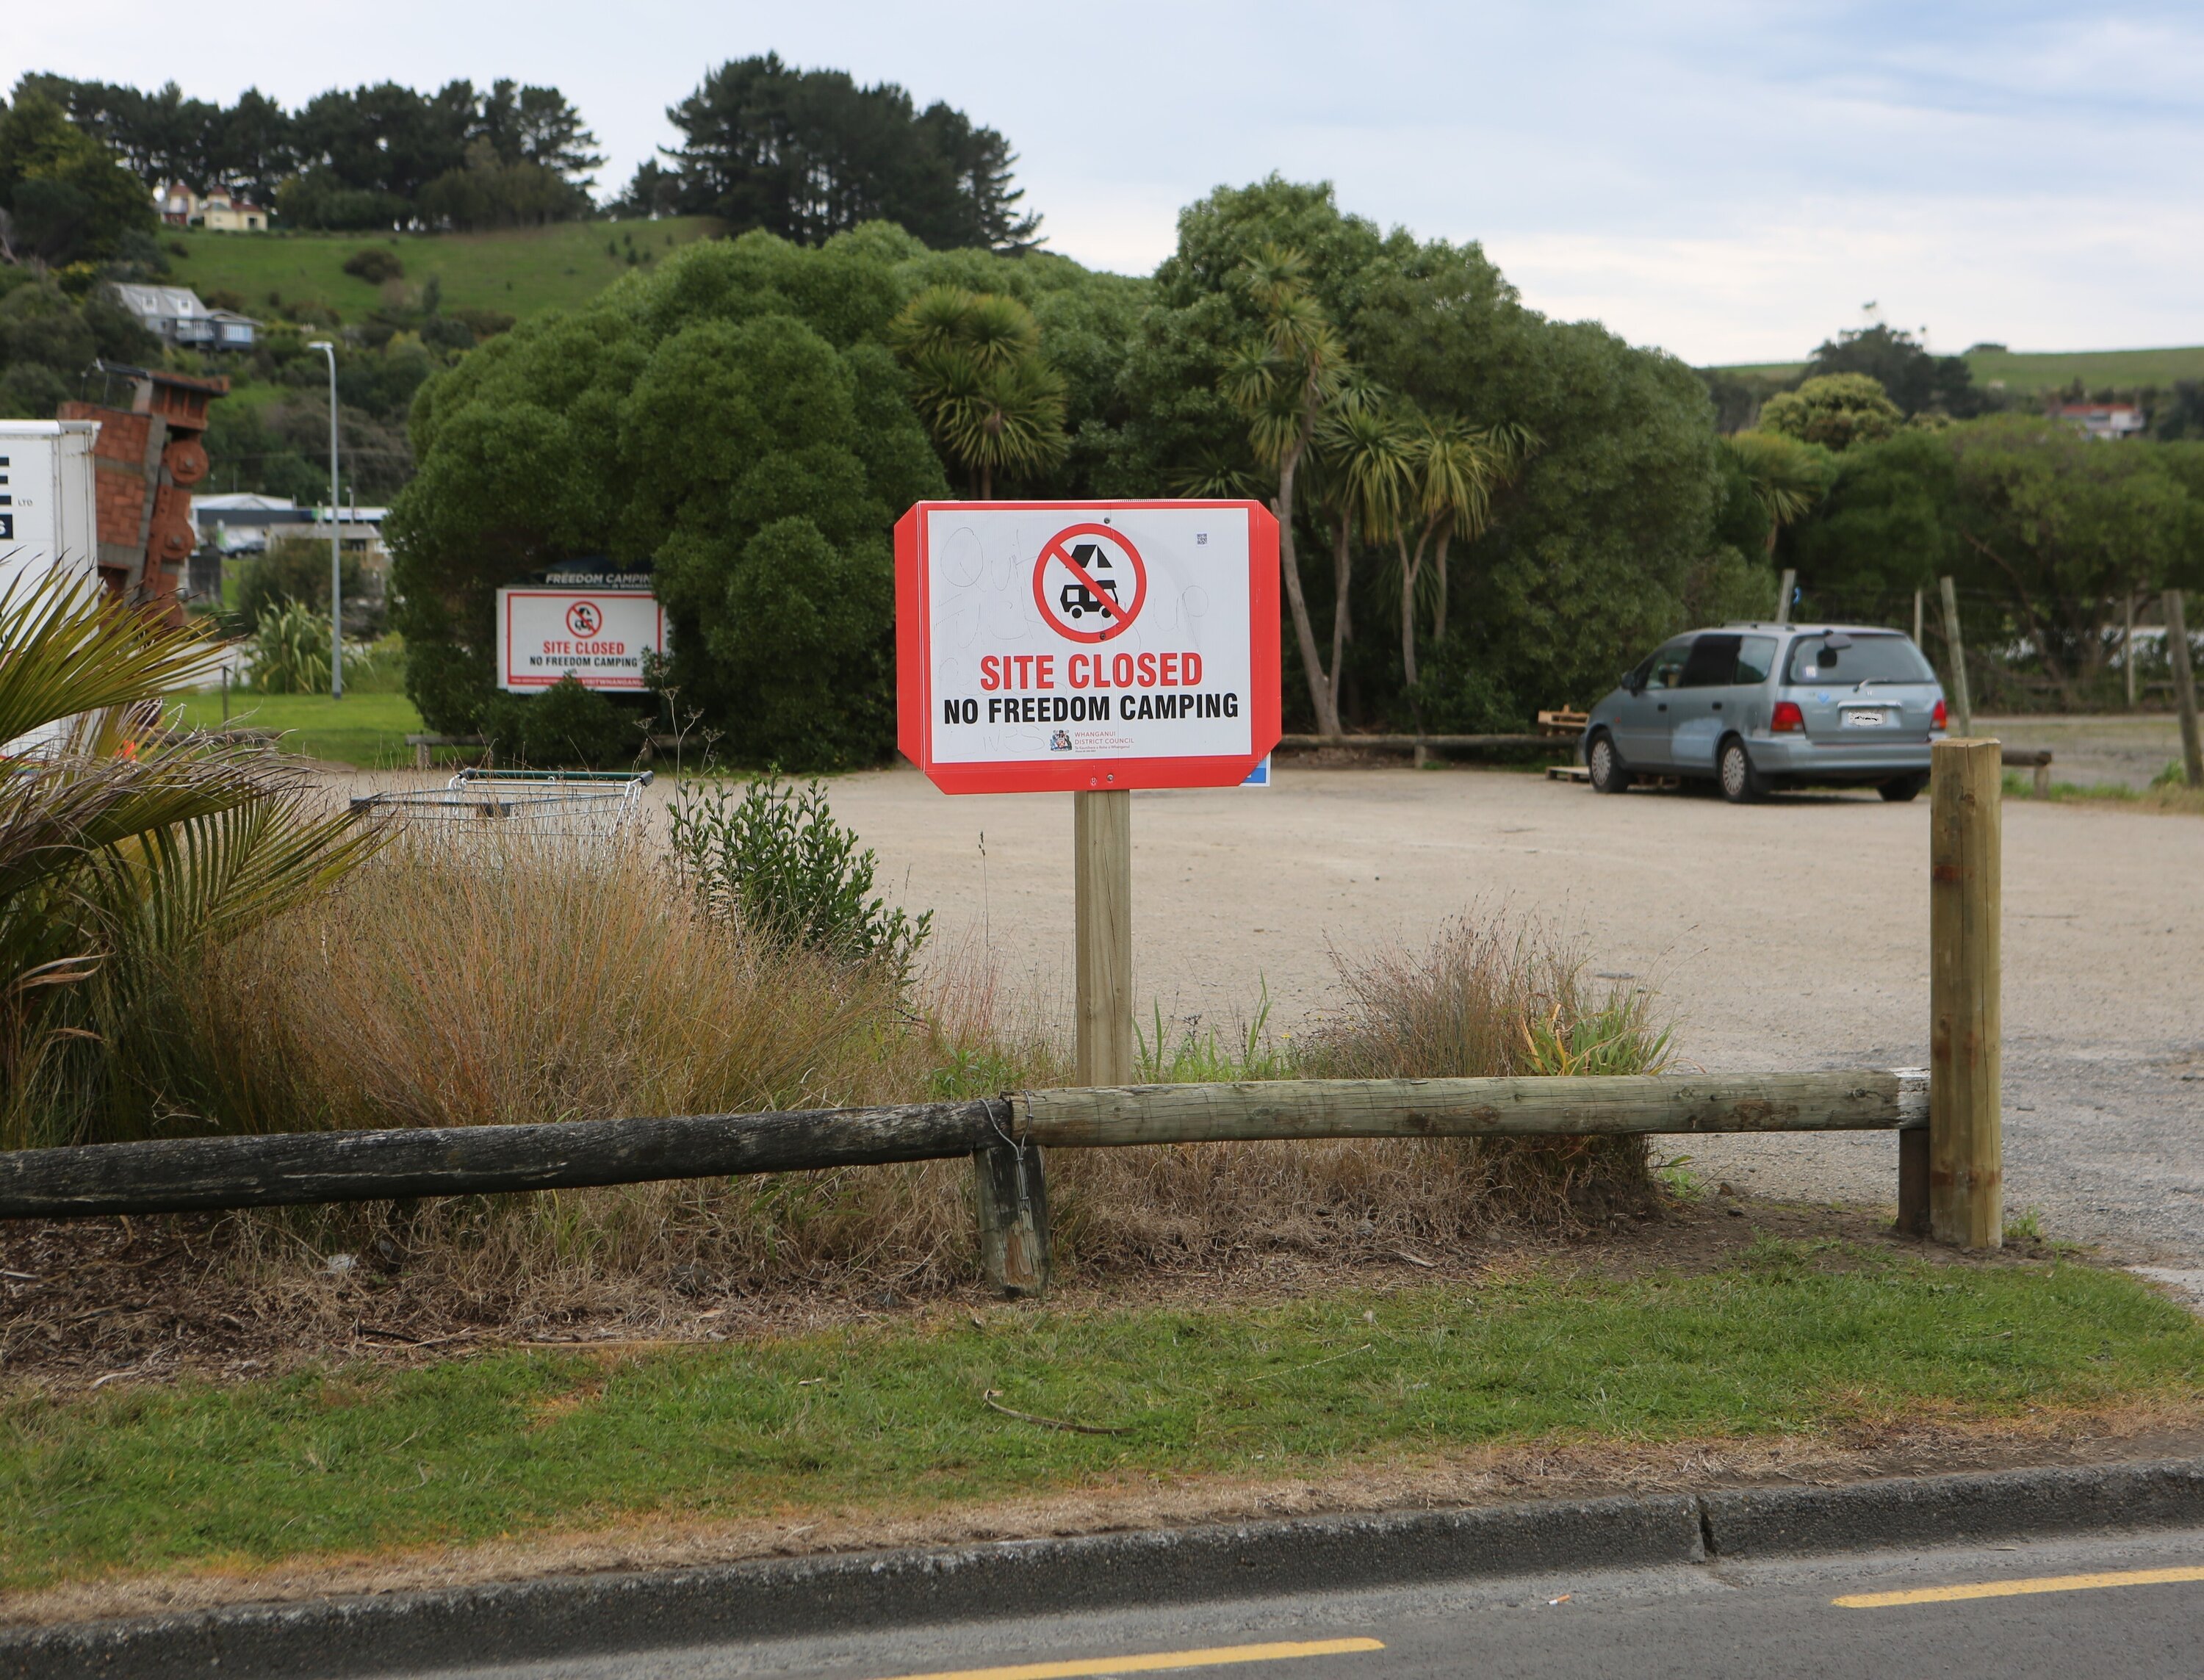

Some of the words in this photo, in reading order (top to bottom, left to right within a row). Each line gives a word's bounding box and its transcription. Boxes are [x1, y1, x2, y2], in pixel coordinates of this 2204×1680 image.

[546, 573, 603, 584] FREEDOM
[605, 573, 653, 584] CAMPIN
[543, 640, 570, 655] SITE
[575, 641, 624, 655] CLOSED
[530, 657, 542, 666] NO
[546, 656, 591, 666] FREEDOM
[594, 657, 638, 667] CAMPING
[980, 655, 1054, 691] SITE
[1068, 652, 1203, 689] CLOSED
[944, 699, 979, 724] NO
[988, 696, 1110, 724] FREEDOM
[1120, 693, 1239, 721] CAMPING
